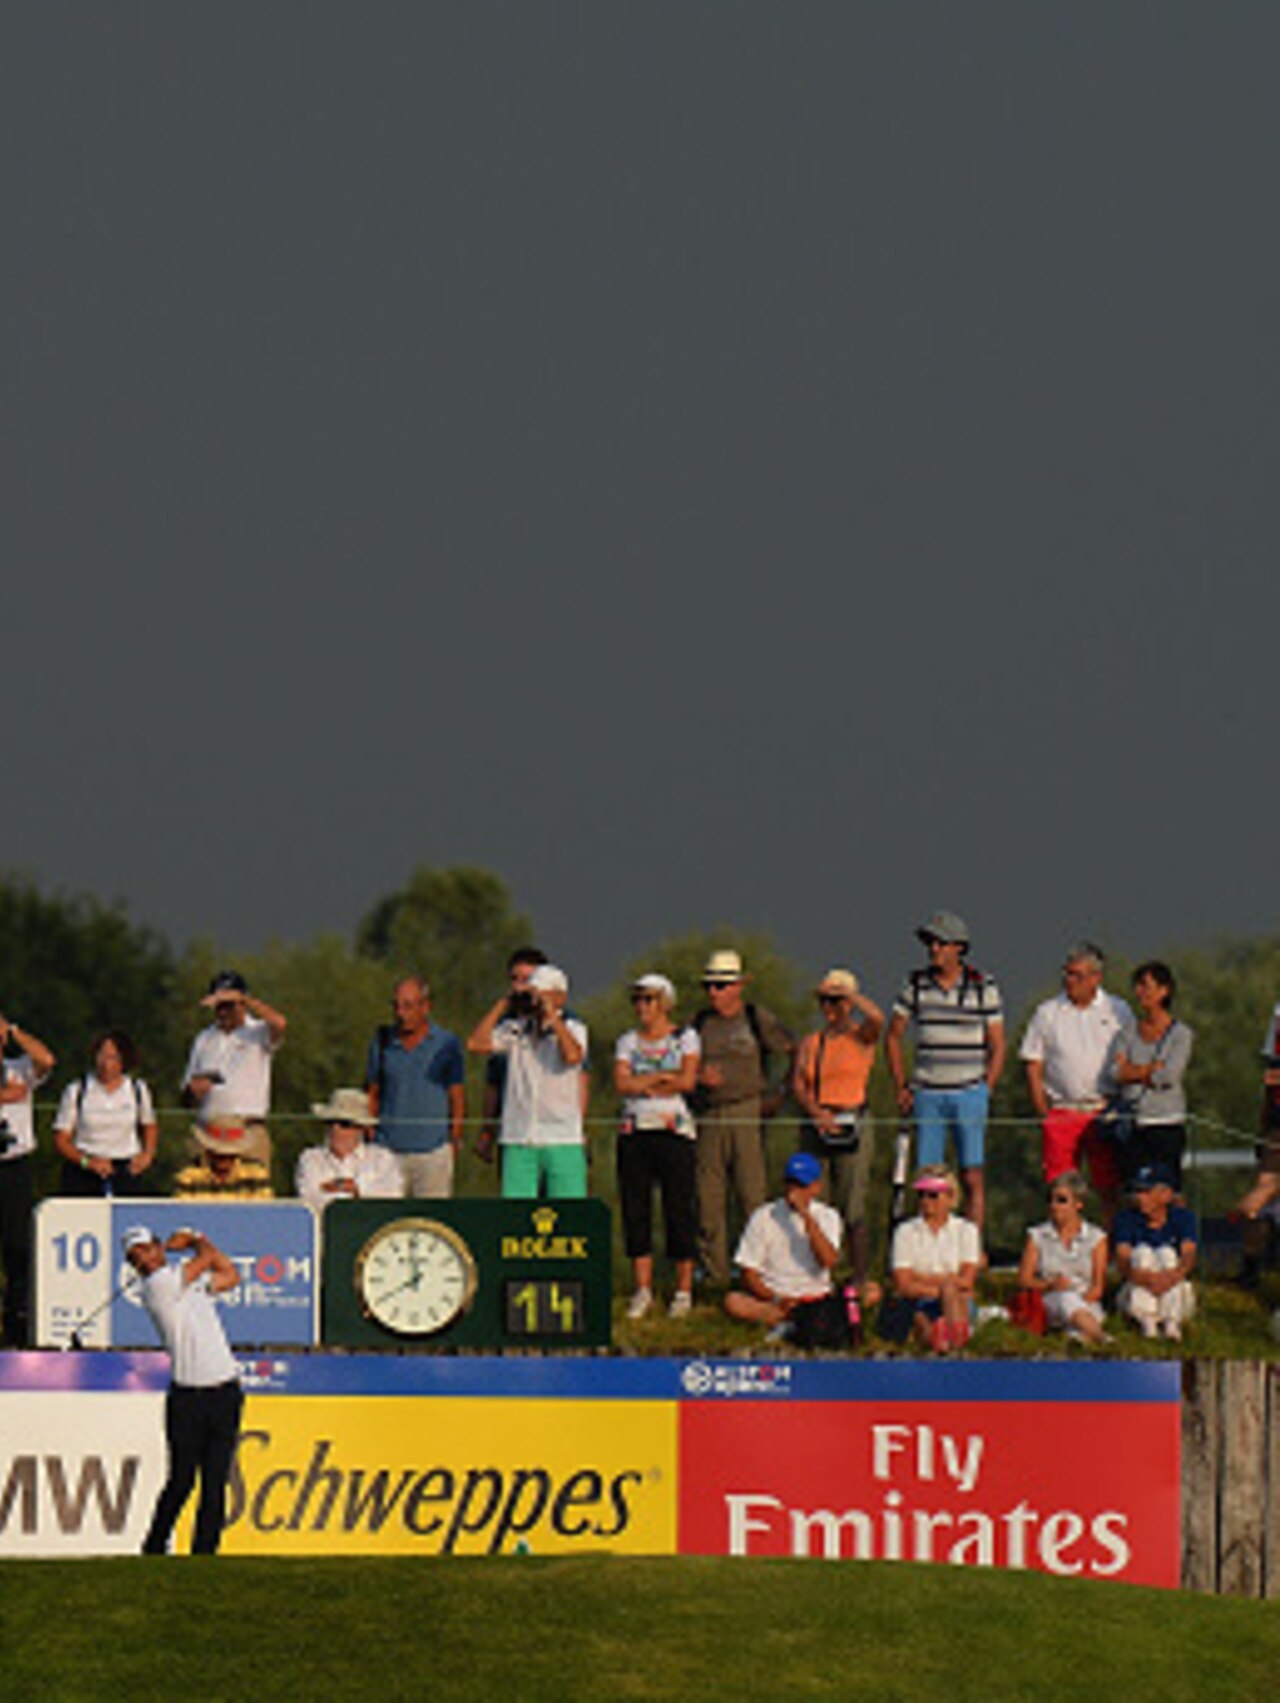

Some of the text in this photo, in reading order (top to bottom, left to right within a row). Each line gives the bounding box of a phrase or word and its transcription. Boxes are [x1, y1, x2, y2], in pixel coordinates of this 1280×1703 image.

[51, 1232, 100, 1272] 10
[501, 1236, 588, 1259] ROLEX
[513, 1281, 574, 1333] 14
[872, 1424, 984, 1491] Fly
[220, 1430, 643, 1554] Schweppes
[724, 1490, 1131, 1575] Emirates
